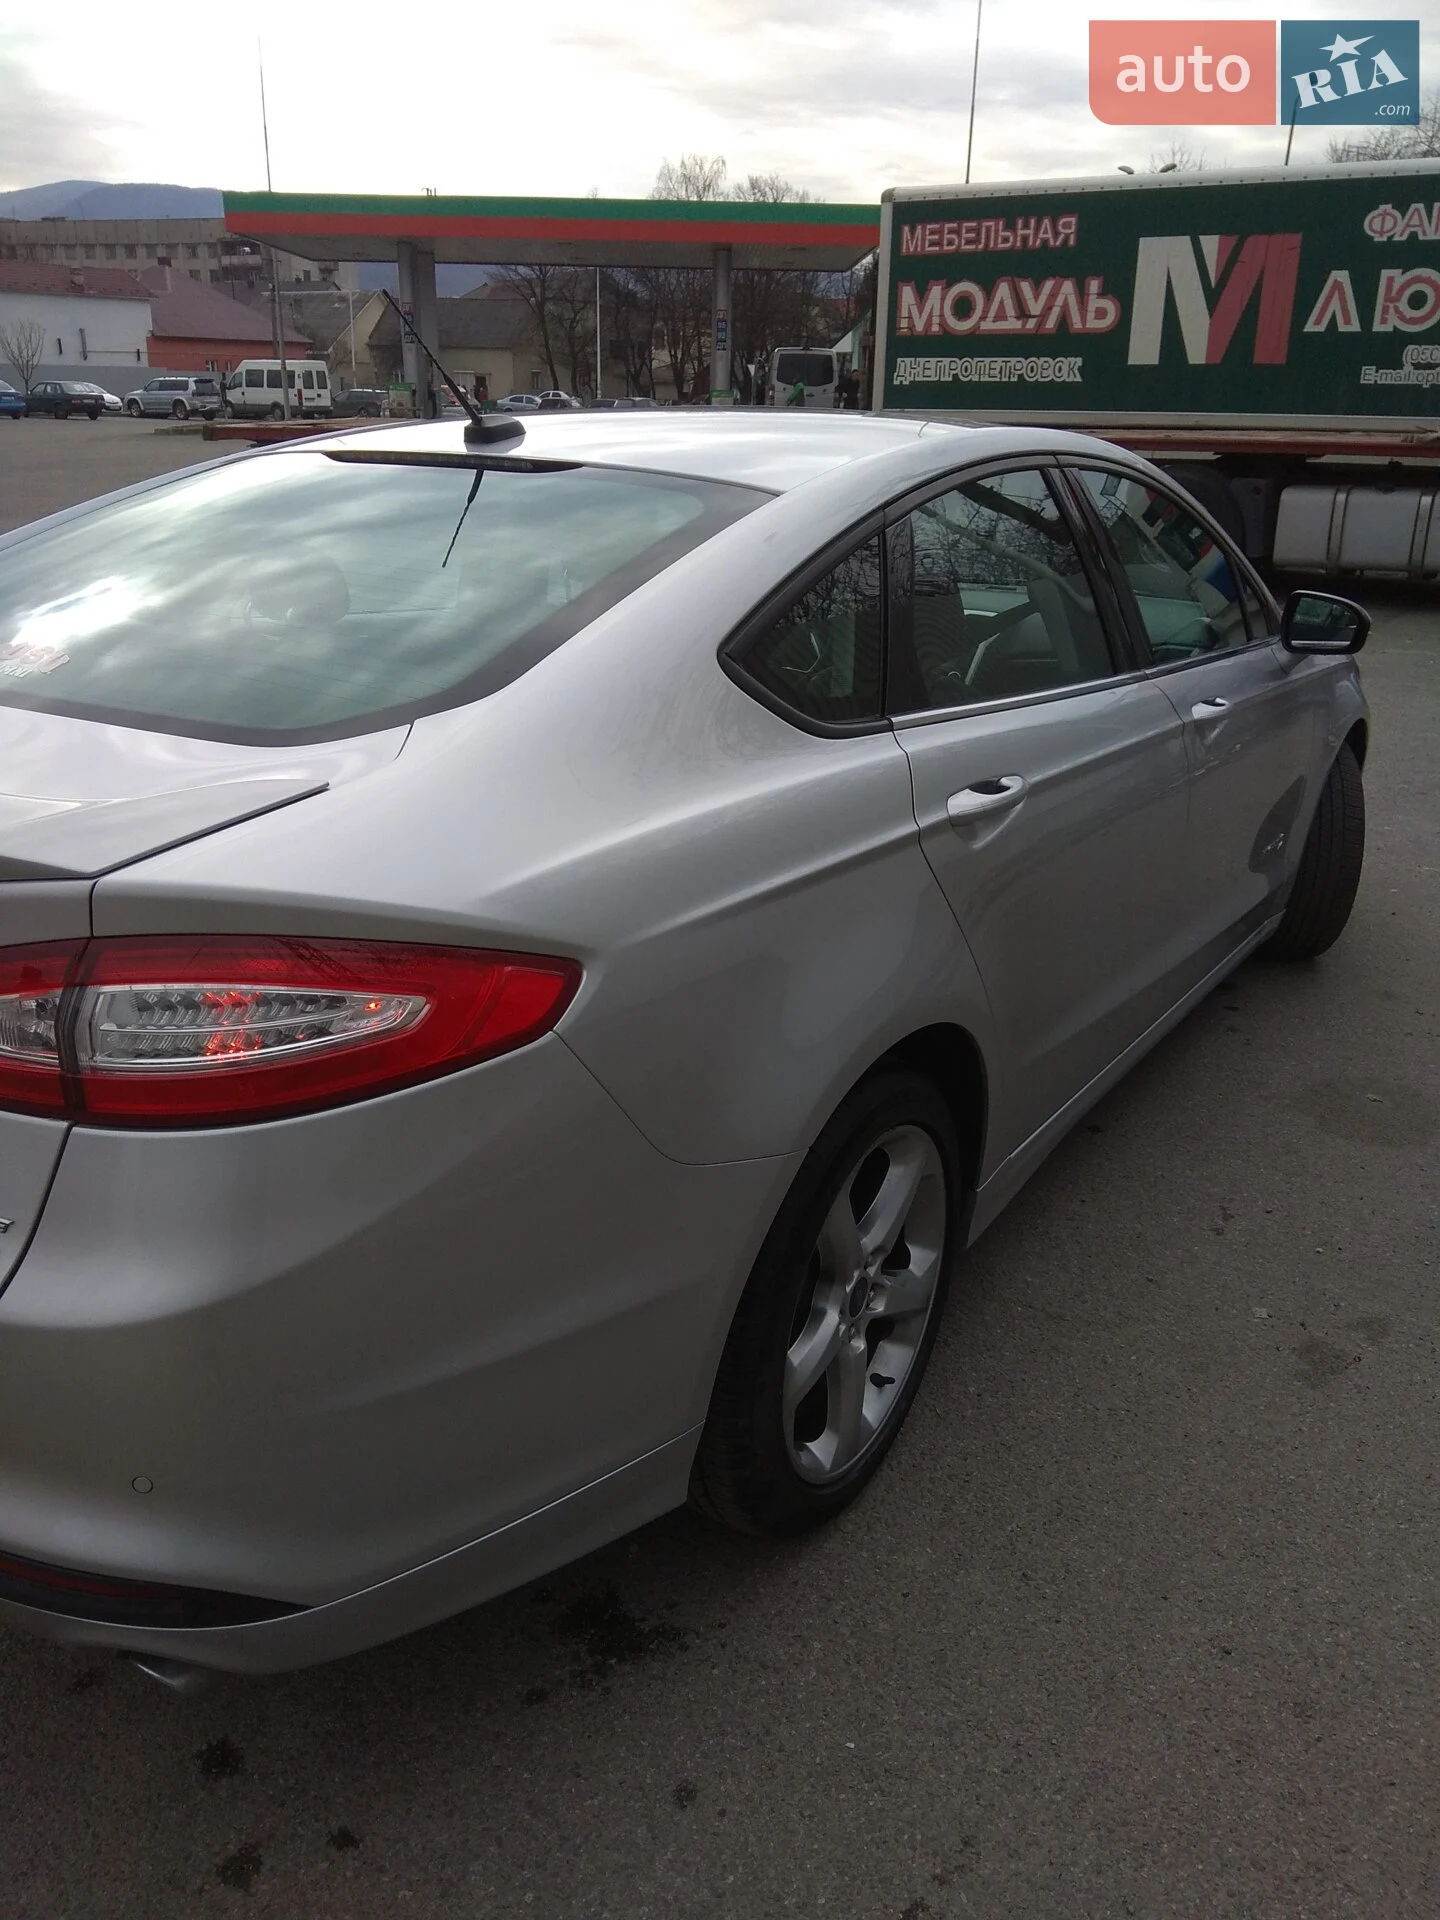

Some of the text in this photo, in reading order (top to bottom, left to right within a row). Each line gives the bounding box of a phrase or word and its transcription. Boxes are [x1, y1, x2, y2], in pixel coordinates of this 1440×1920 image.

[900, 214, 1078, 256] МЕБЕЛЬНАЯ
[896, 276, 1121, 335] МОДУЛЬ
[894, 357, 1082, 385] ДНЕПРОПЕТРОВСК
